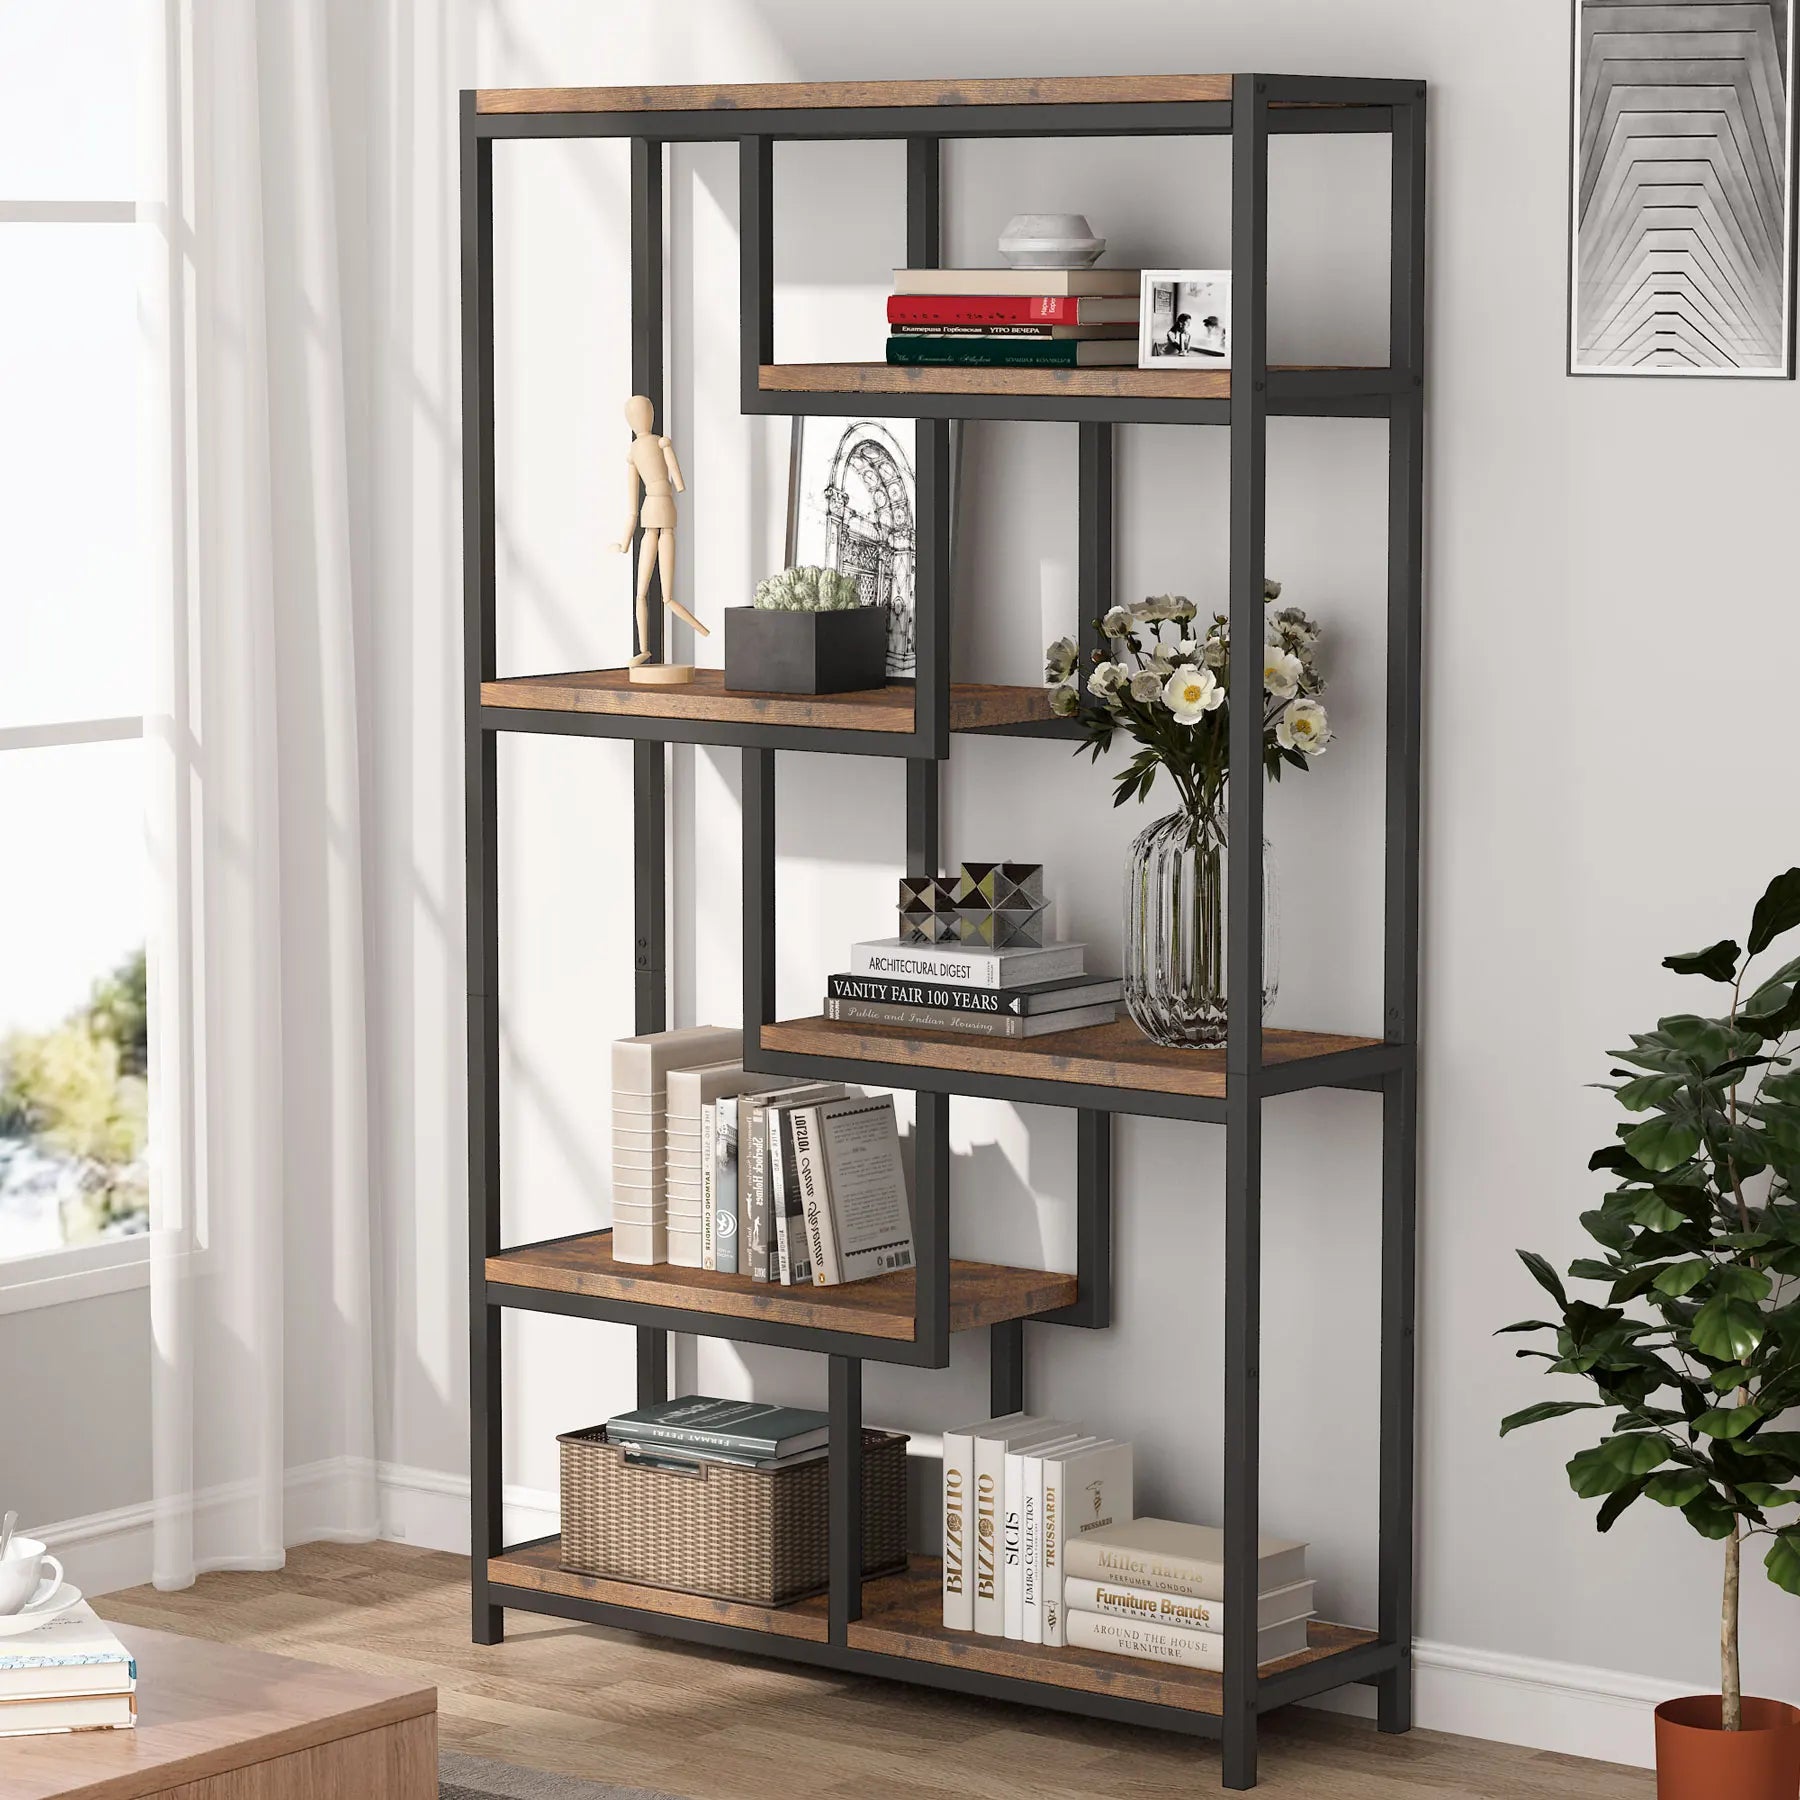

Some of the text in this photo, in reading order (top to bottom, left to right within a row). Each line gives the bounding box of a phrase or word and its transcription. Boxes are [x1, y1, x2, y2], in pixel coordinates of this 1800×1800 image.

[869, 957, 937, 976] ARCHITECTURAL
[940, 964, 971, 979] DIGEST
[834, 980, 998, 1011] VANITY FAIR 100 YEARS
[848, 1007, 880, 1019] Public
[884, 1012, 904, 1022] and
[908, 1013, 944, 1025] Indian
[949, 1015, 993, 1032] Housing
[1006, 1512, 1019, 1565] SICIS
[1046, 1487, 1055, 1568] TRUSSARDI
[1025, 1496, 1036, 1606] JUMBO COLLECTION
[1098, 1551, 1147, 1573] Miller
[1110, 1574, 1193, 1593] PERFUMER LONDON
[1096, 1588, 1209, 1621] Furniture Brands
[1097, 1604, 1210, 1628] INTERNATIONAL
[1094, 1624, 1208, 1652] AROUND THE HOUSE
[1119, 1639, 1182, 1658] FURNITURE
